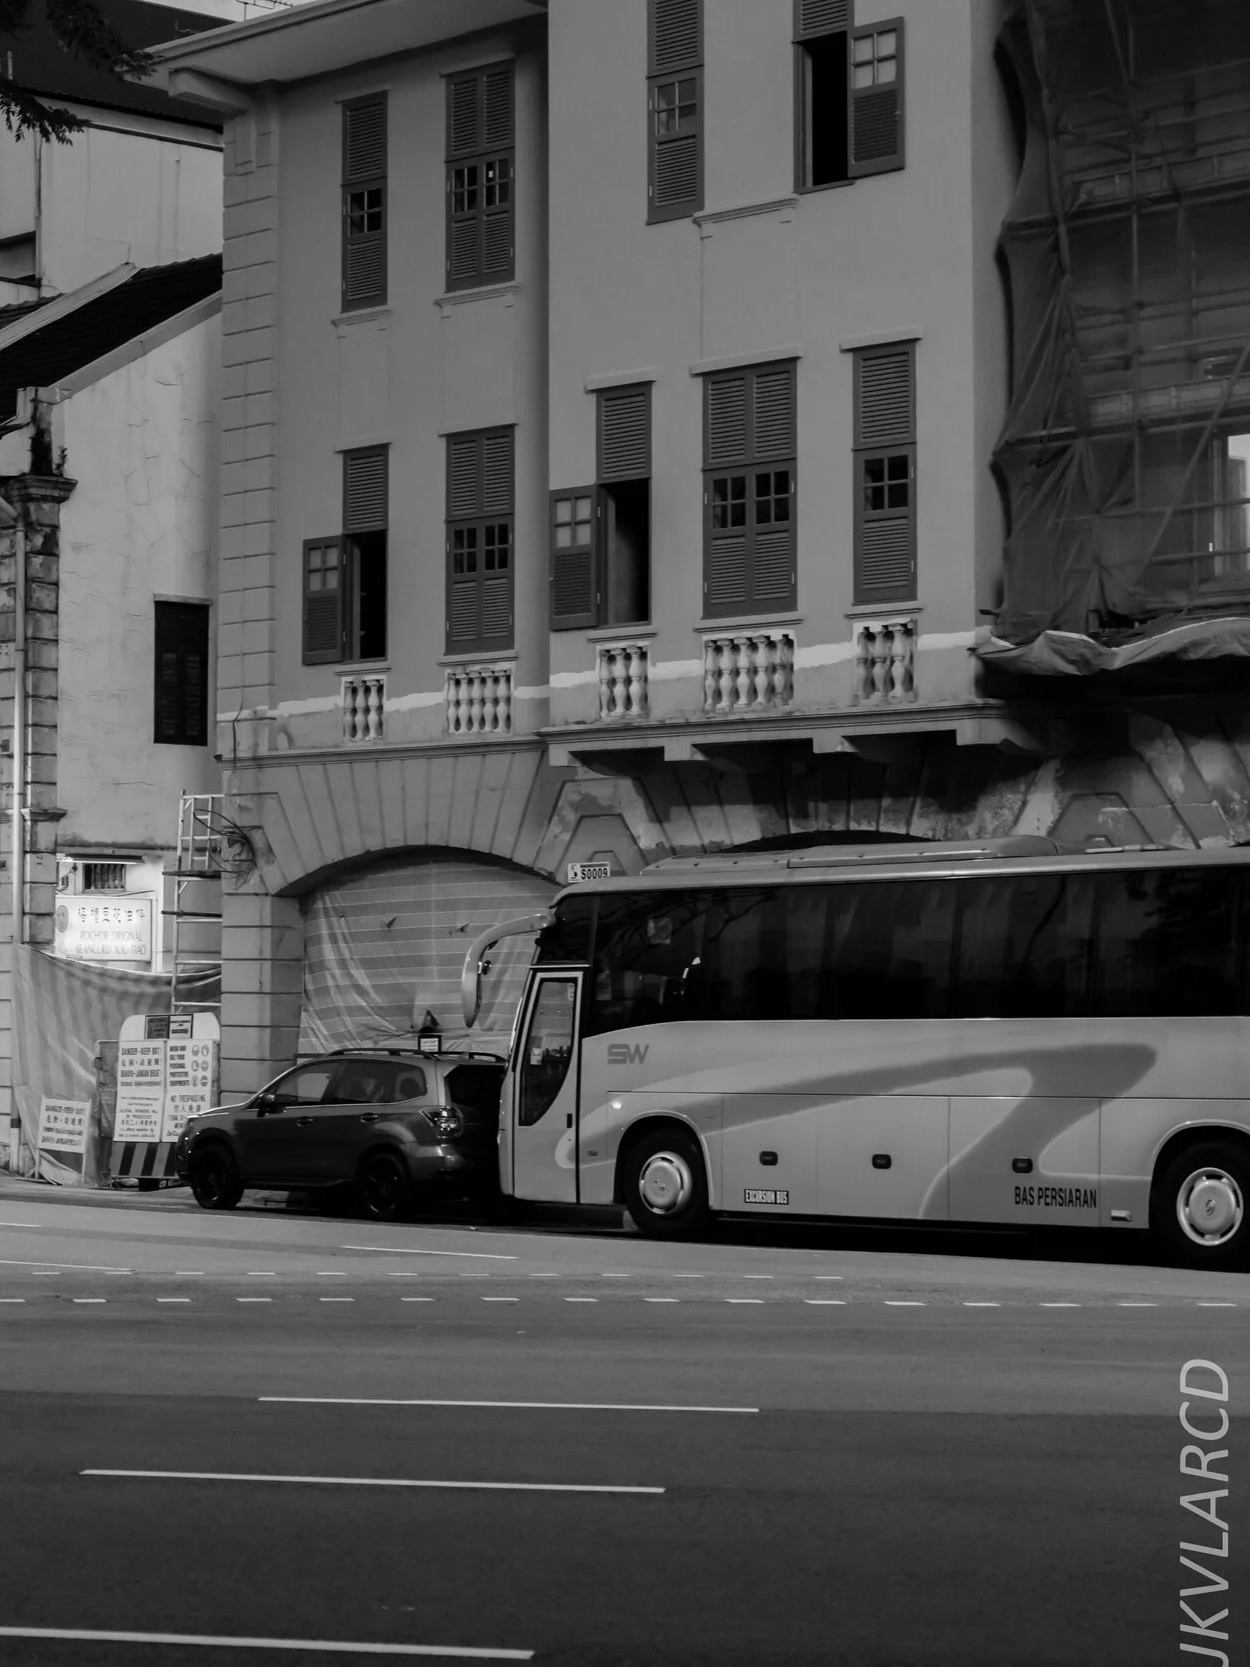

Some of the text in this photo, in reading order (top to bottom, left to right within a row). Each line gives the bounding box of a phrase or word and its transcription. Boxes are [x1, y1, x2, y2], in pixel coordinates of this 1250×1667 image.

[580, 867, 608, 880] S0009
[607, 1043, 650, 1065] SW
[745, 1190, 788, 1204] EXCURSION BUS
[1014, 1185, 1097, 1209] BAS PERSIARAN
